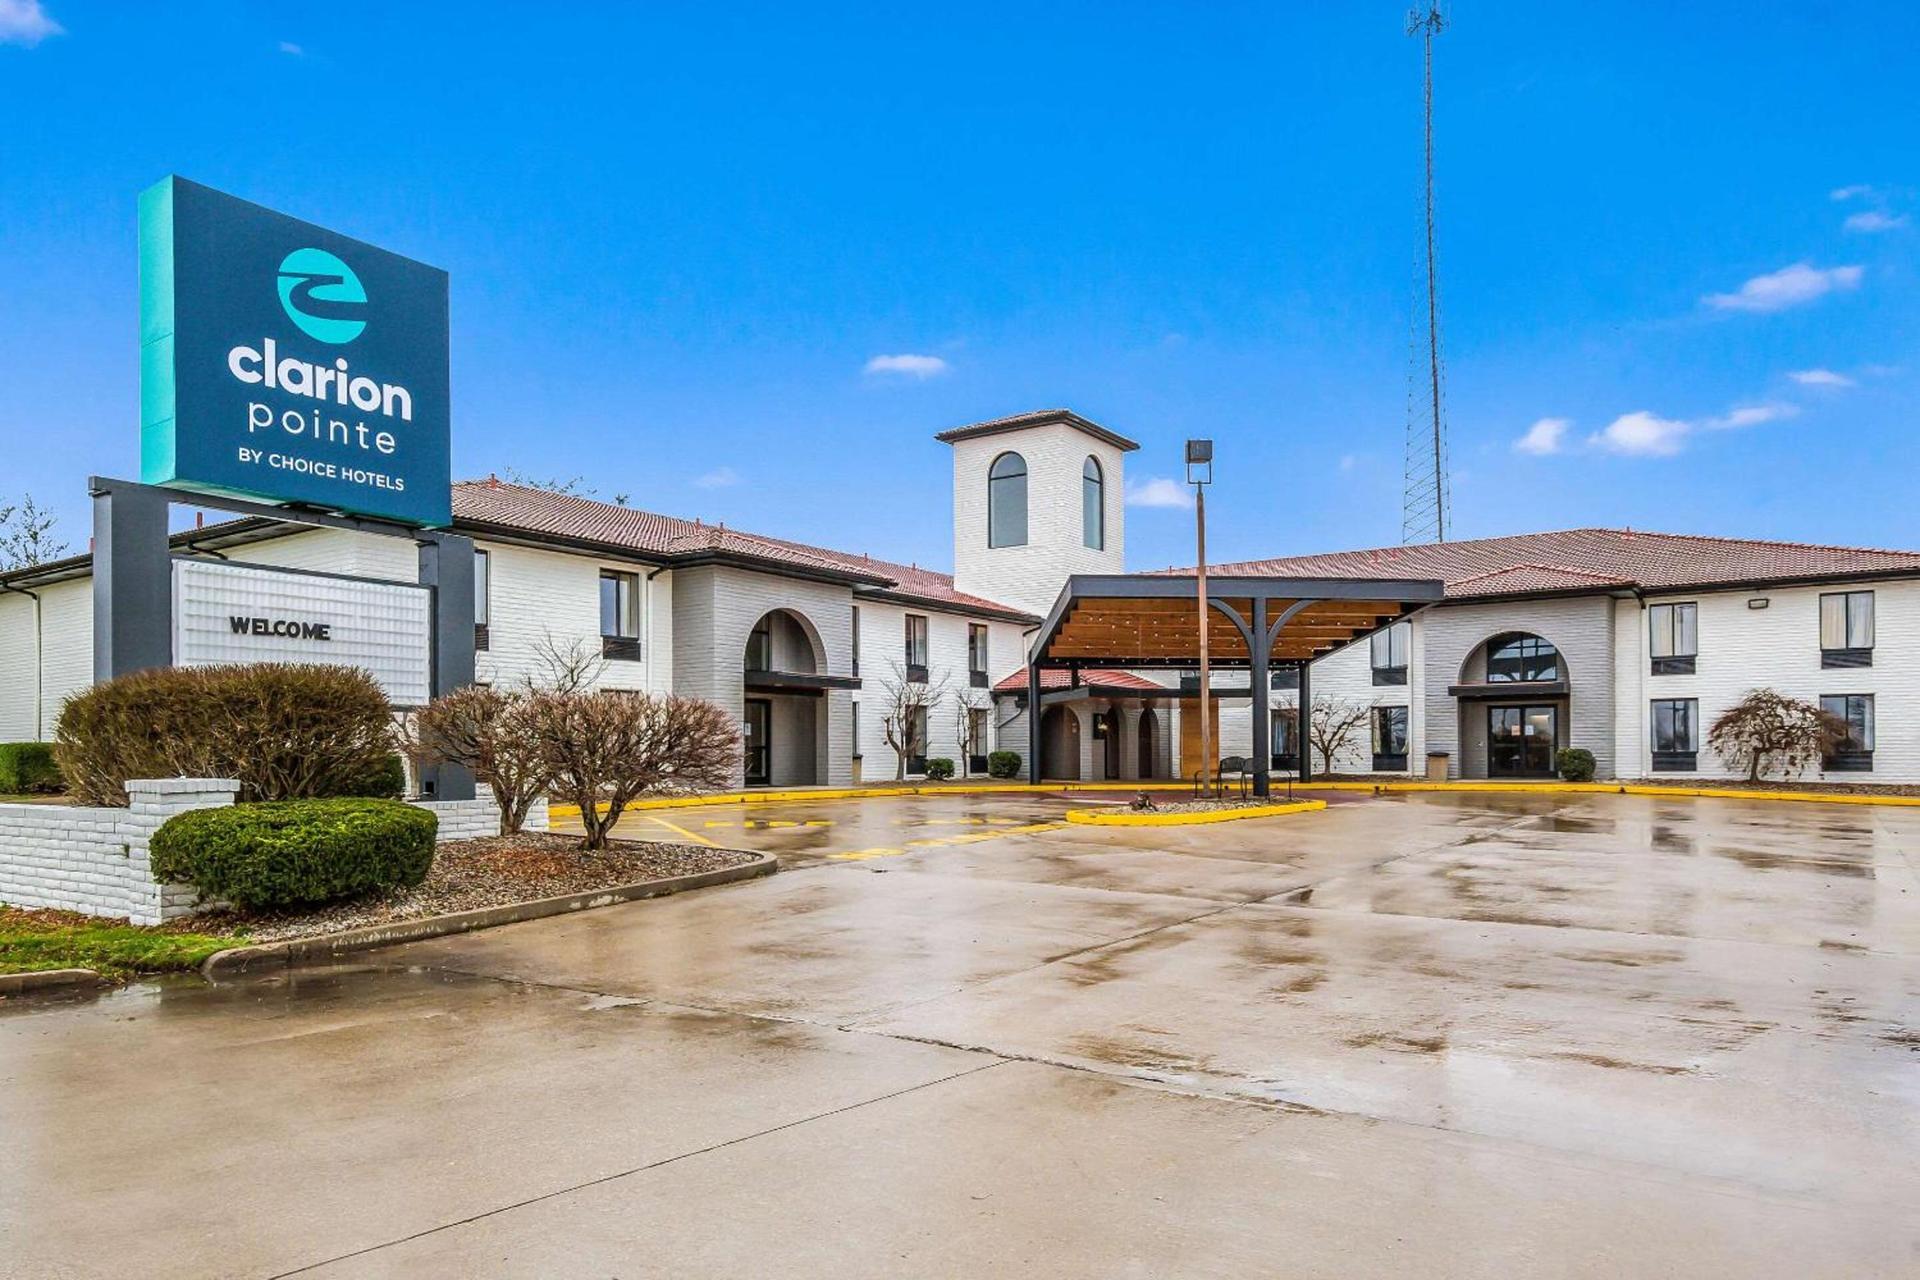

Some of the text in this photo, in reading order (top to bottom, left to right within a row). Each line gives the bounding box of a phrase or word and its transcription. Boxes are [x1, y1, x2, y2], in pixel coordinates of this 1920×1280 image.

[228, 337, 412, 421] clarion
[248, 402, 396, 454] pointe
[238, 447, 405, 491] BY CHOICE HOTELS
[230, 616, 331, 641] WELCOME
